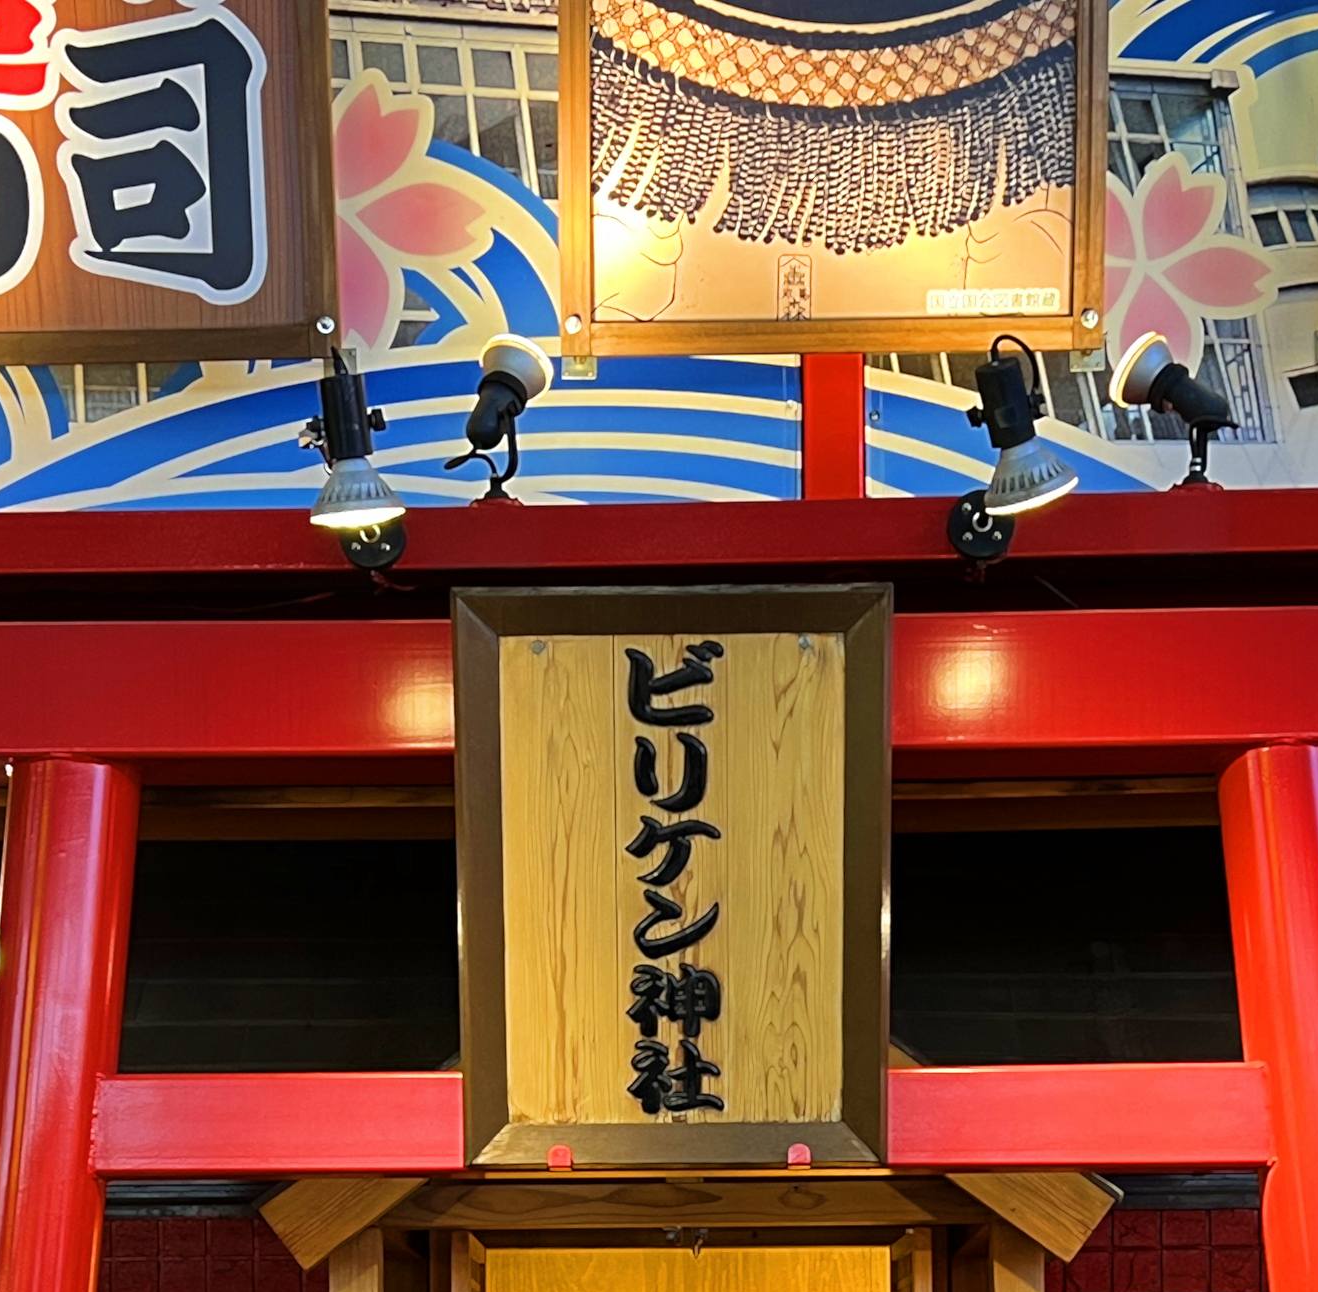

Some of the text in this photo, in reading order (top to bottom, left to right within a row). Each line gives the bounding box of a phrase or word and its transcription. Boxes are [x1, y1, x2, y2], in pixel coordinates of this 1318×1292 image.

[64, 18, 254, 292] 司
[624, 640, 725, 1115] ビリケン神社
